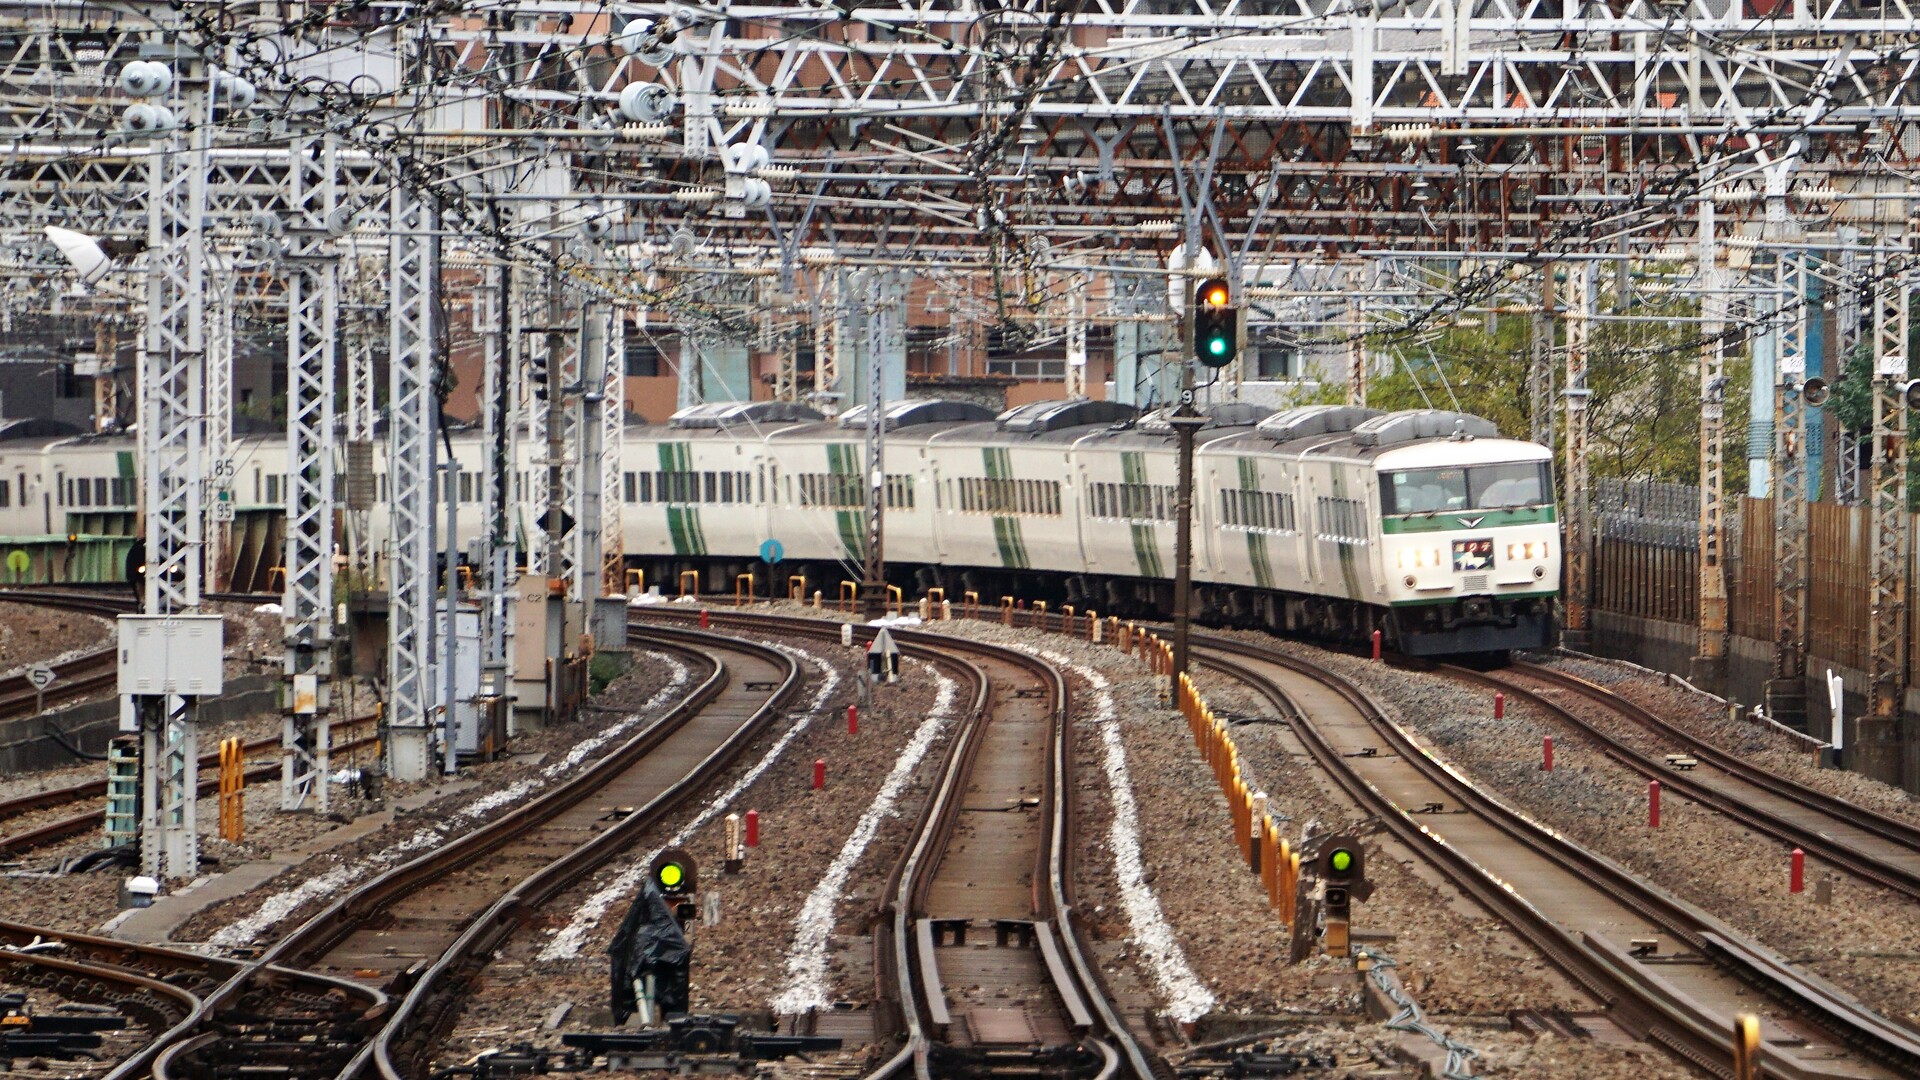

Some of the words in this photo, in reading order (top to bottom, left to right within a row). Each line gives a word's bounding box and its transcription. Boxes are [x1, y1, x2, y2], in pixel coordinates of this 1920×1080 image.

[1182, 389, 1193, 405] 9
[215, 459, 234, 476] 85
[217, 503, 231, 518] 95
[33, 669, 49, 685] 5
